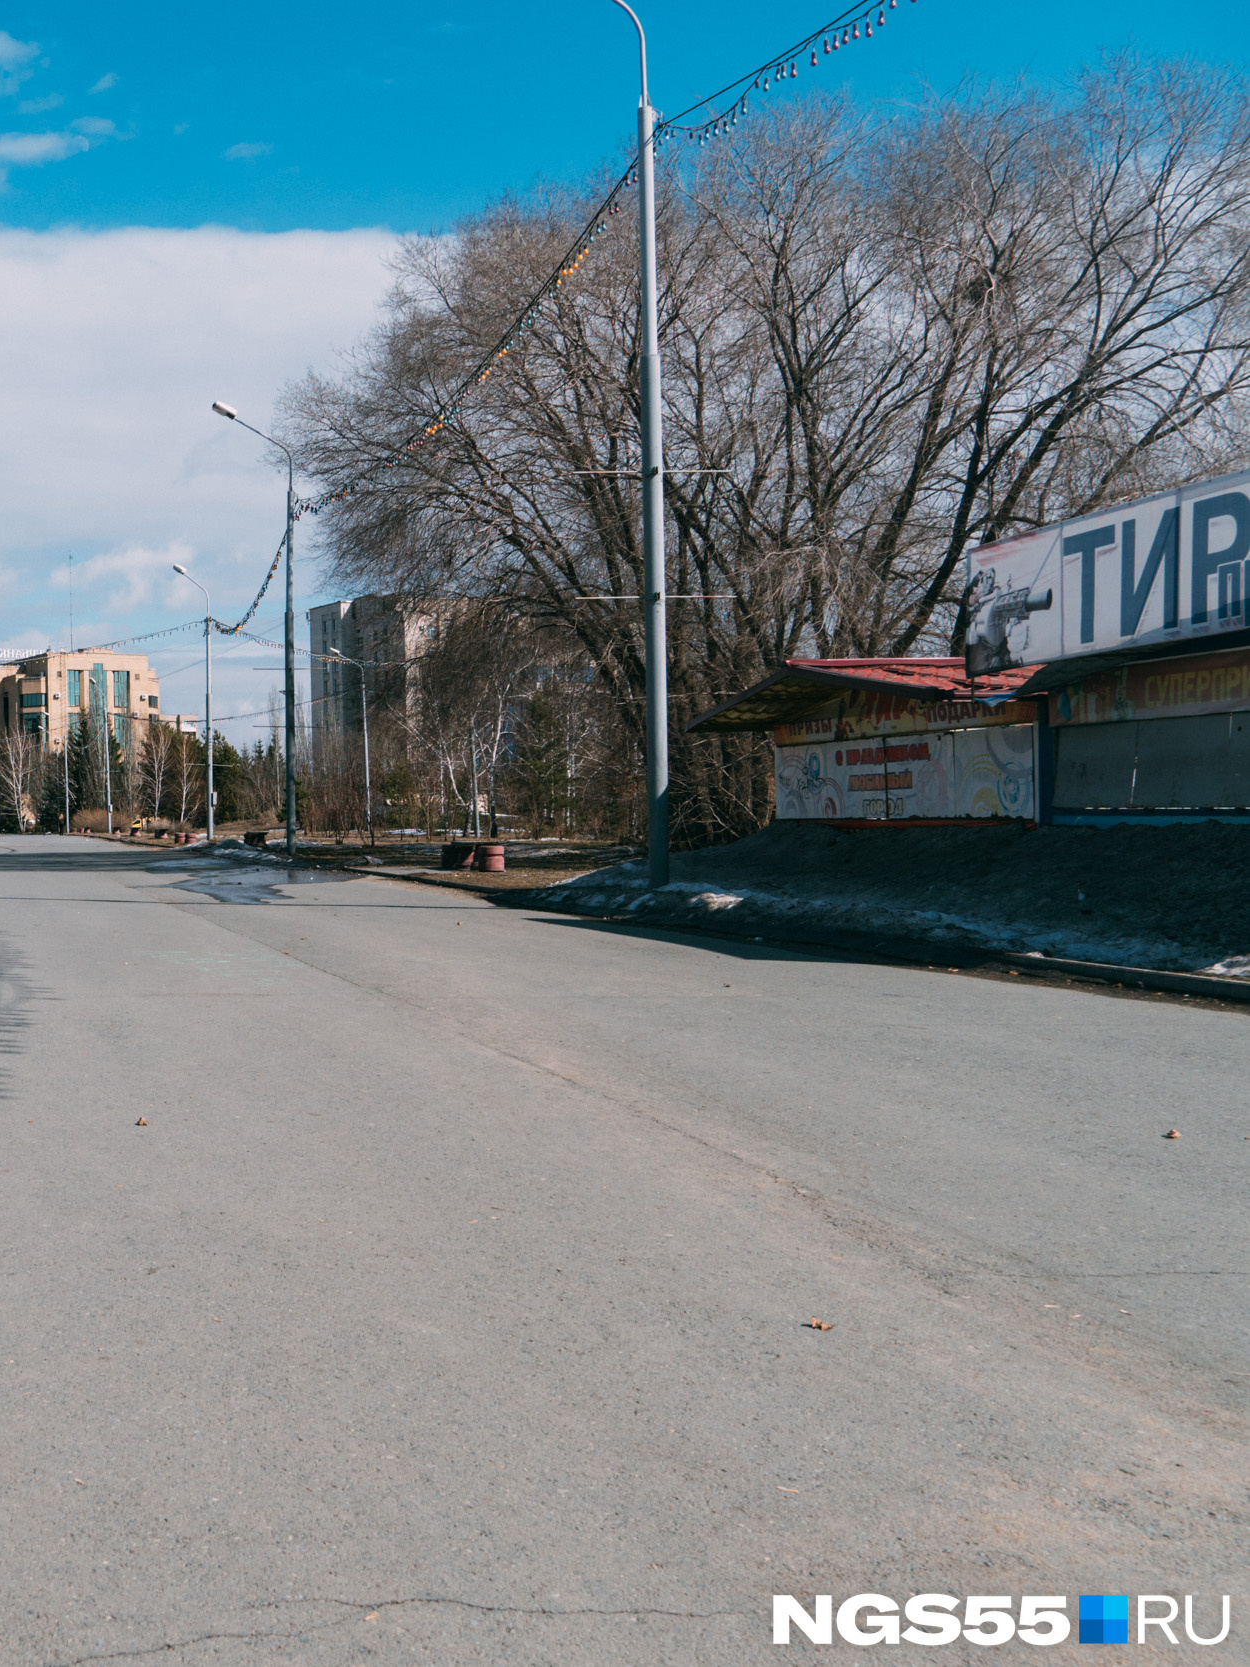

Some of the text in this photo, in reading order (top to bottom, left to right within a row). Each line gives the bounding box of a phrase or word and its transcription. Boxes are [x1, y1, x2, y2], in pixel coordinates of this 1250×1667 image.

[1063, 492, 1250, 644] ТИР
[926, 701, 1006, 723] ПОДАРКИ
[789, 717, 832, 736] ПРИЗЫ
[835, 750, 844, 766] С
[862, 798, 904, 816] ГОРОД
